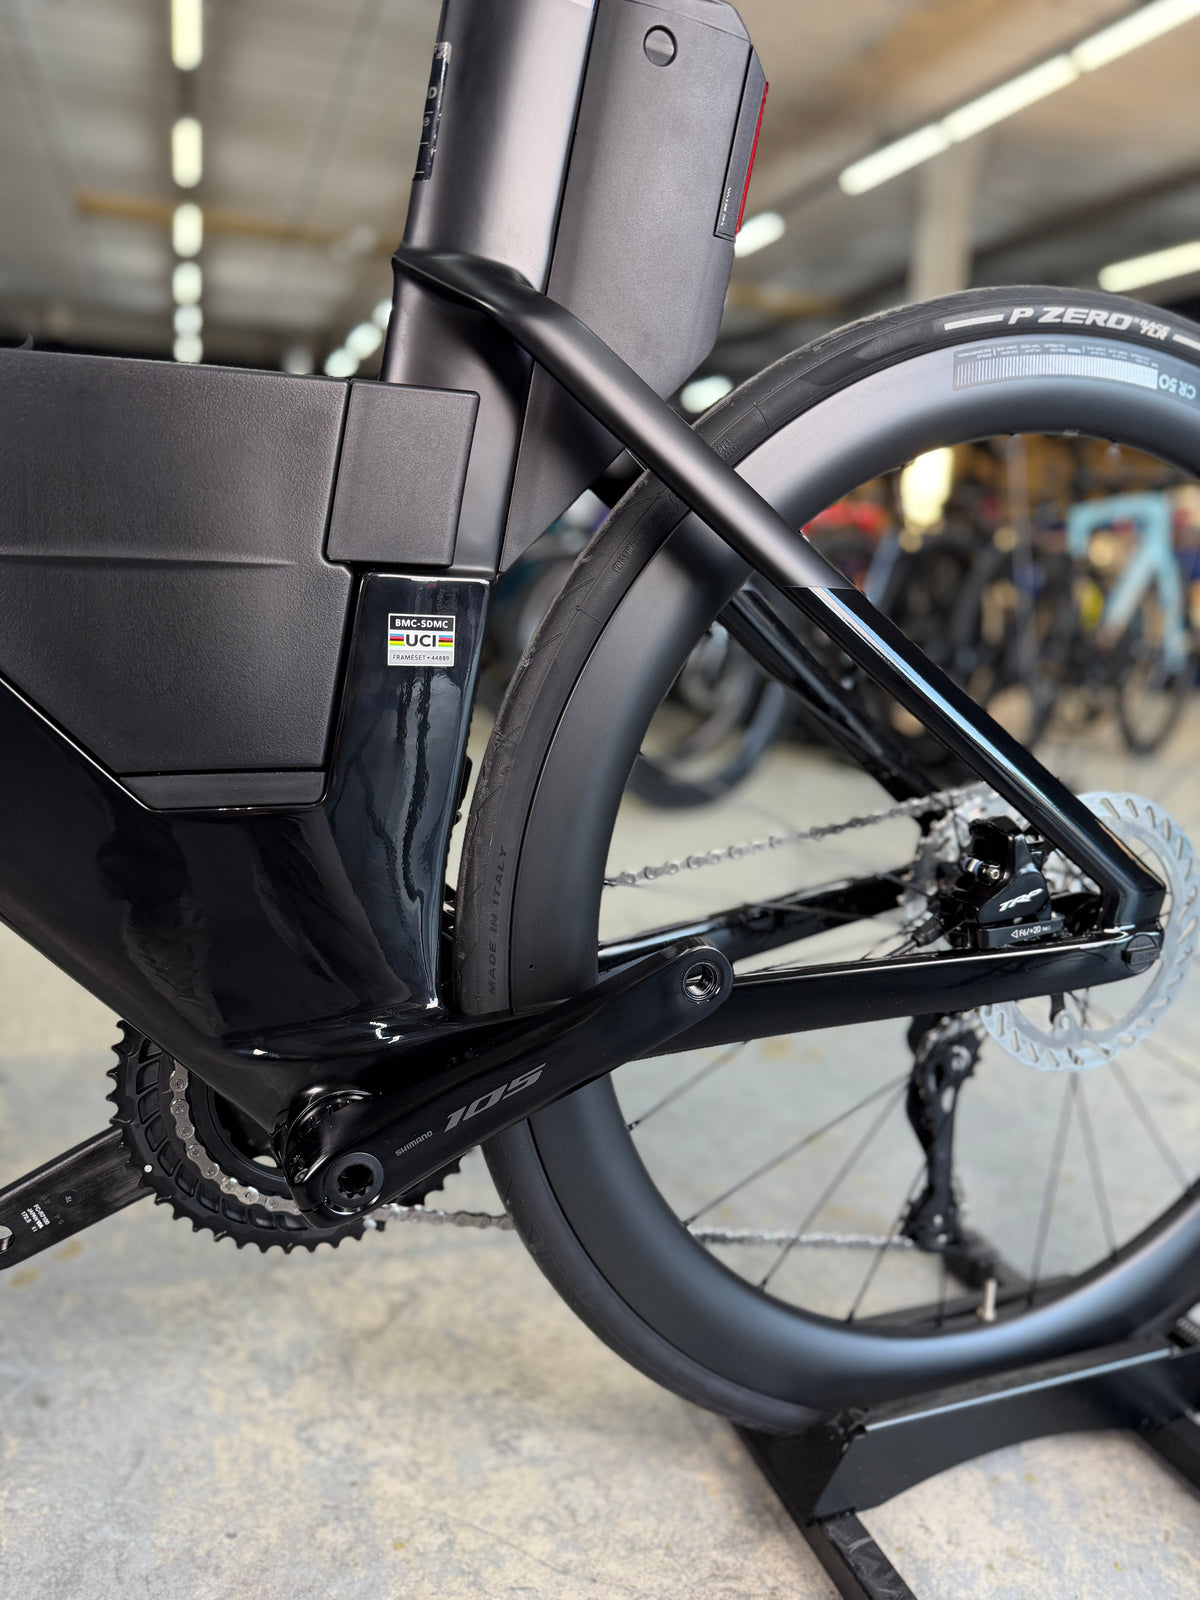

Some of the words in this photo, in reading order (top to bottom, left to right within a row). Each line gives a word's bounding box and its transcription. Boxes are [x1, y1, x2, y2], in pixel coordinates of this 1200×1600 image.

[1008, 307, 1034, 325] P
[1038, 307, 1132, 331] ZERO
[395, 618, 449, 629] BMC-SDMC
[405, 634, 437, 648] UCI
[493, 845, 507, 905] ITALY
[998, 888, 1043, 912] TRP
[490, 914, 499, 933] IN
[488, 940, 497, 995] MADE
[443, 1062, 547, 1133] 105
[394, 1130, 434, 1157] SHIMANO
